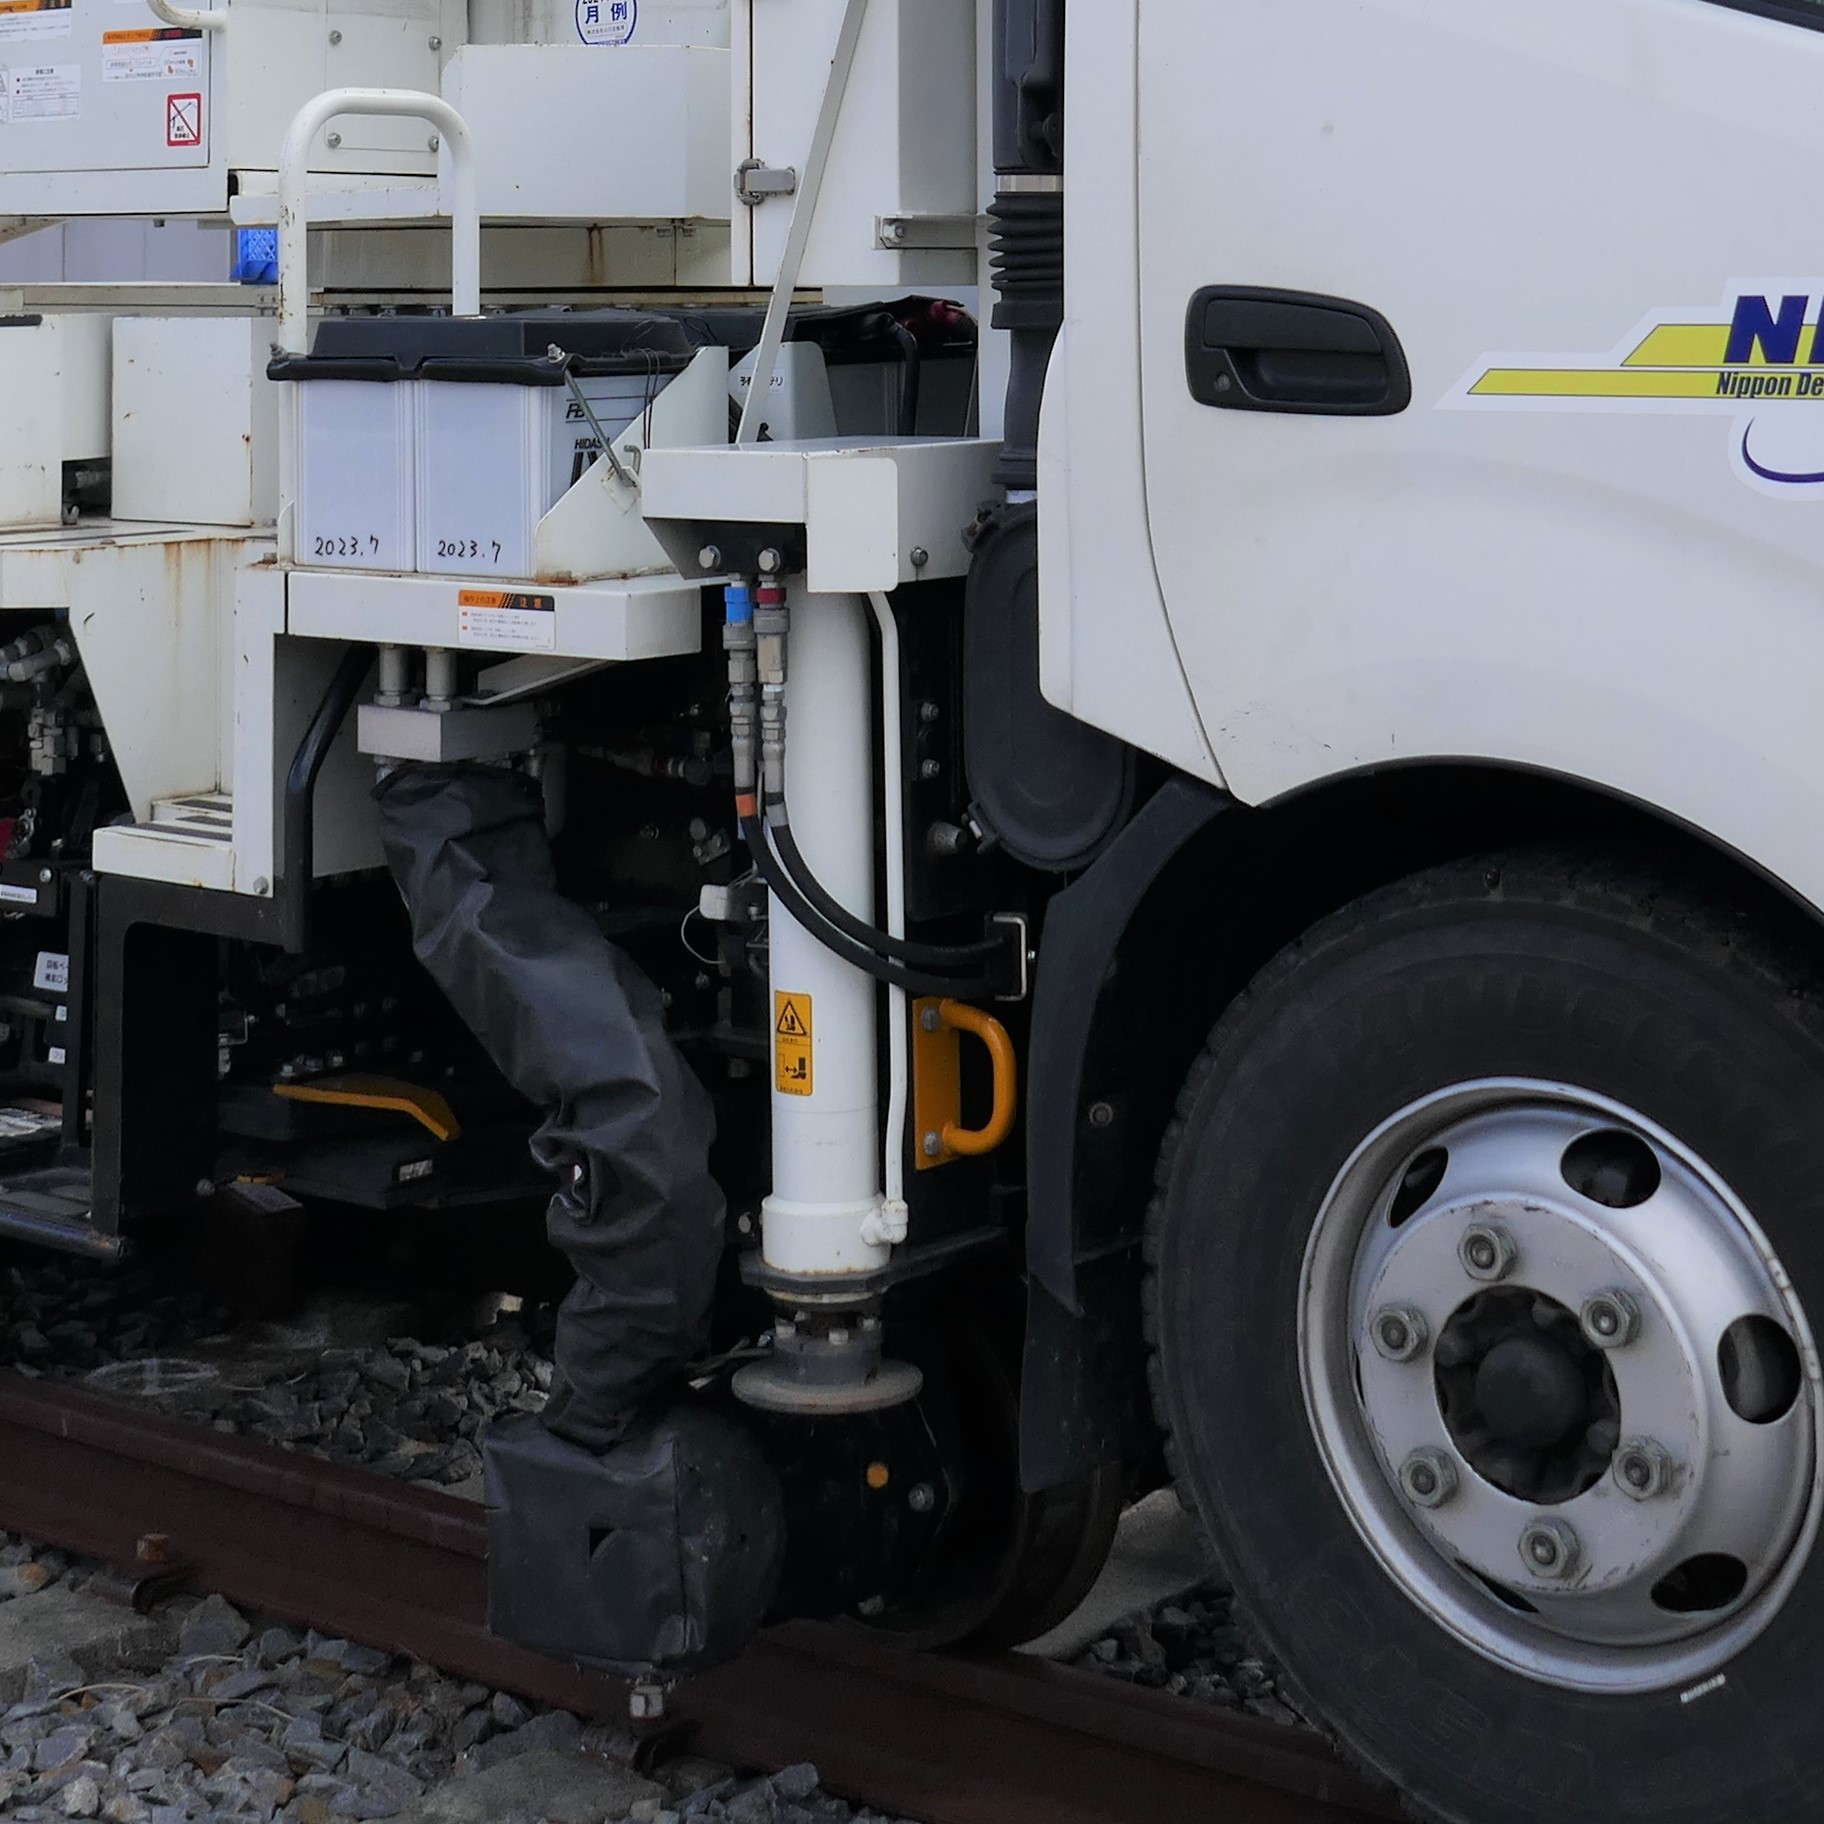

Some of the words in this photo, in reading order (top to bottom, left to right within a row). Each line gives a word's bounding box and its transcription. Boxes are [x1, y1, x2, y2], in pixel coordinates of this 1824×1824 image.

[585, 1, 627, 24] 月例
[1716, 372, 1792, 398] Nippon
[315, 534, 379, 557] 2023.7
[437, 539, 501, 564] 2023.7
